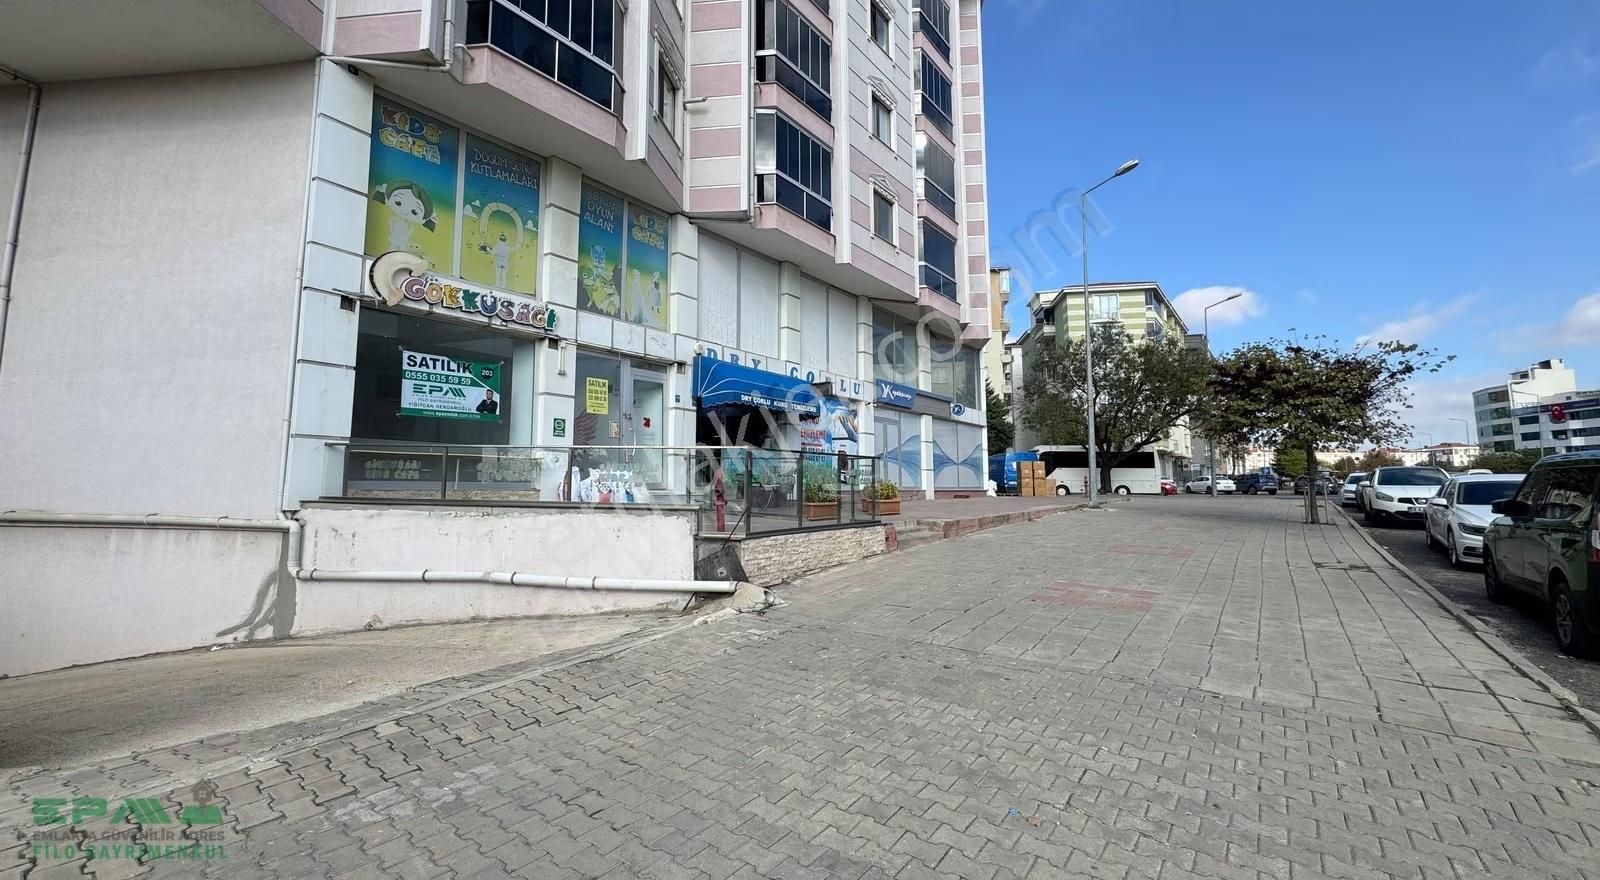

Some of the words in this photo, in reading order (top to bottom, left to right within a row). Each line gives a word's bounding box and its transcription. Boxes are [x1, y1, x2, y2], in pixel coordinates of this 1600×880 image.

[470, 161, 537, 189] KUTLAMALARI
[587, 200, 614, 221] OYUN
[583, 212, 614, 234] ALANI
[406, 354, 472, 375] SATILIK
[481, 369, 493, 377] 203
[405, 371, 428, 380] 0555
[430, 374, 446, 382] 035
[448, 376, 458, 384] 59
[588, 380, 607, 389] SATILIK
